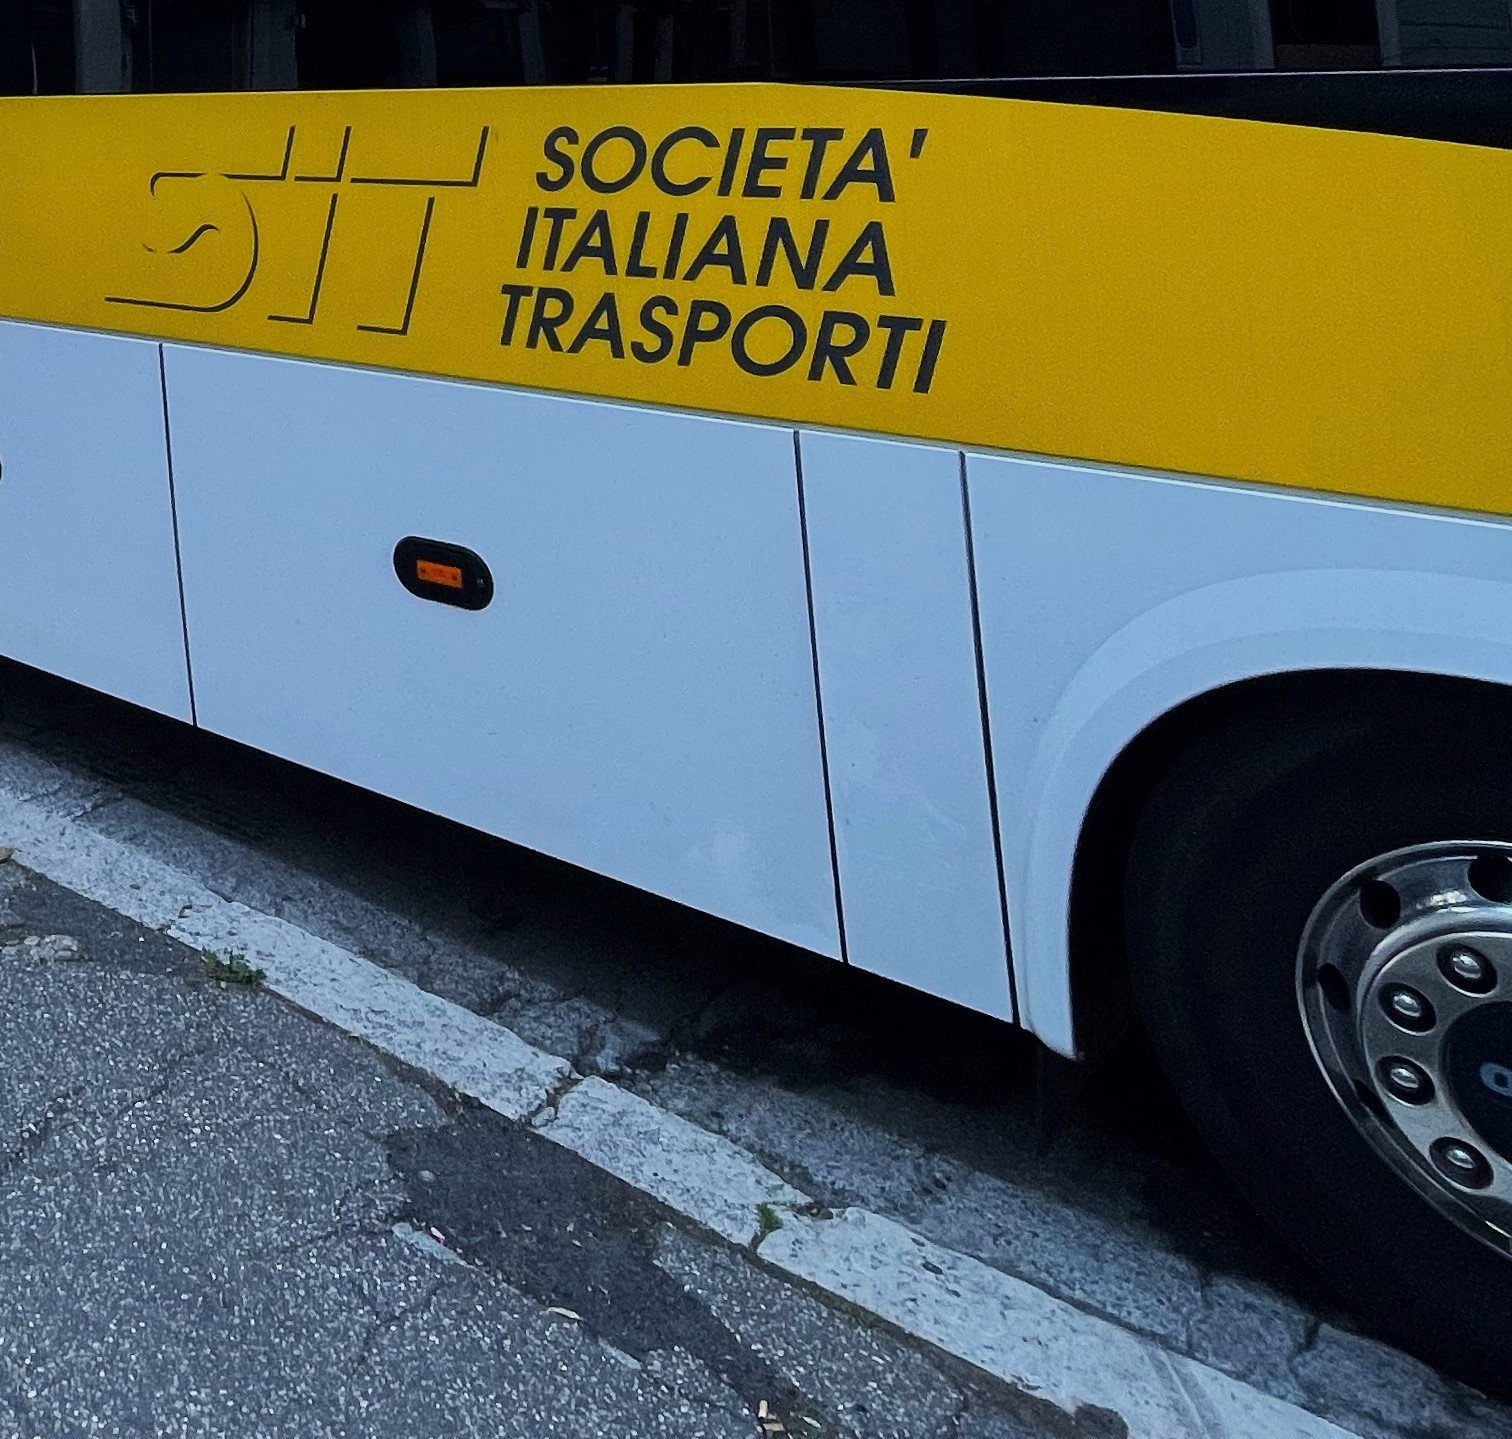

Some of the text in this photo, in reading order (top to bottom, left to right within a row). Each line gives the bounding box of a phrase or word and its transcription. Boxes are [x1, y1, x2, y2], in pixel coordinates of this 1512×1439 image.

[535, 125, 929, 203] SOCIETA'
[515, 206, 896, 297] ITALIANA
[500, 283, 948, 395] TRASPORTI
